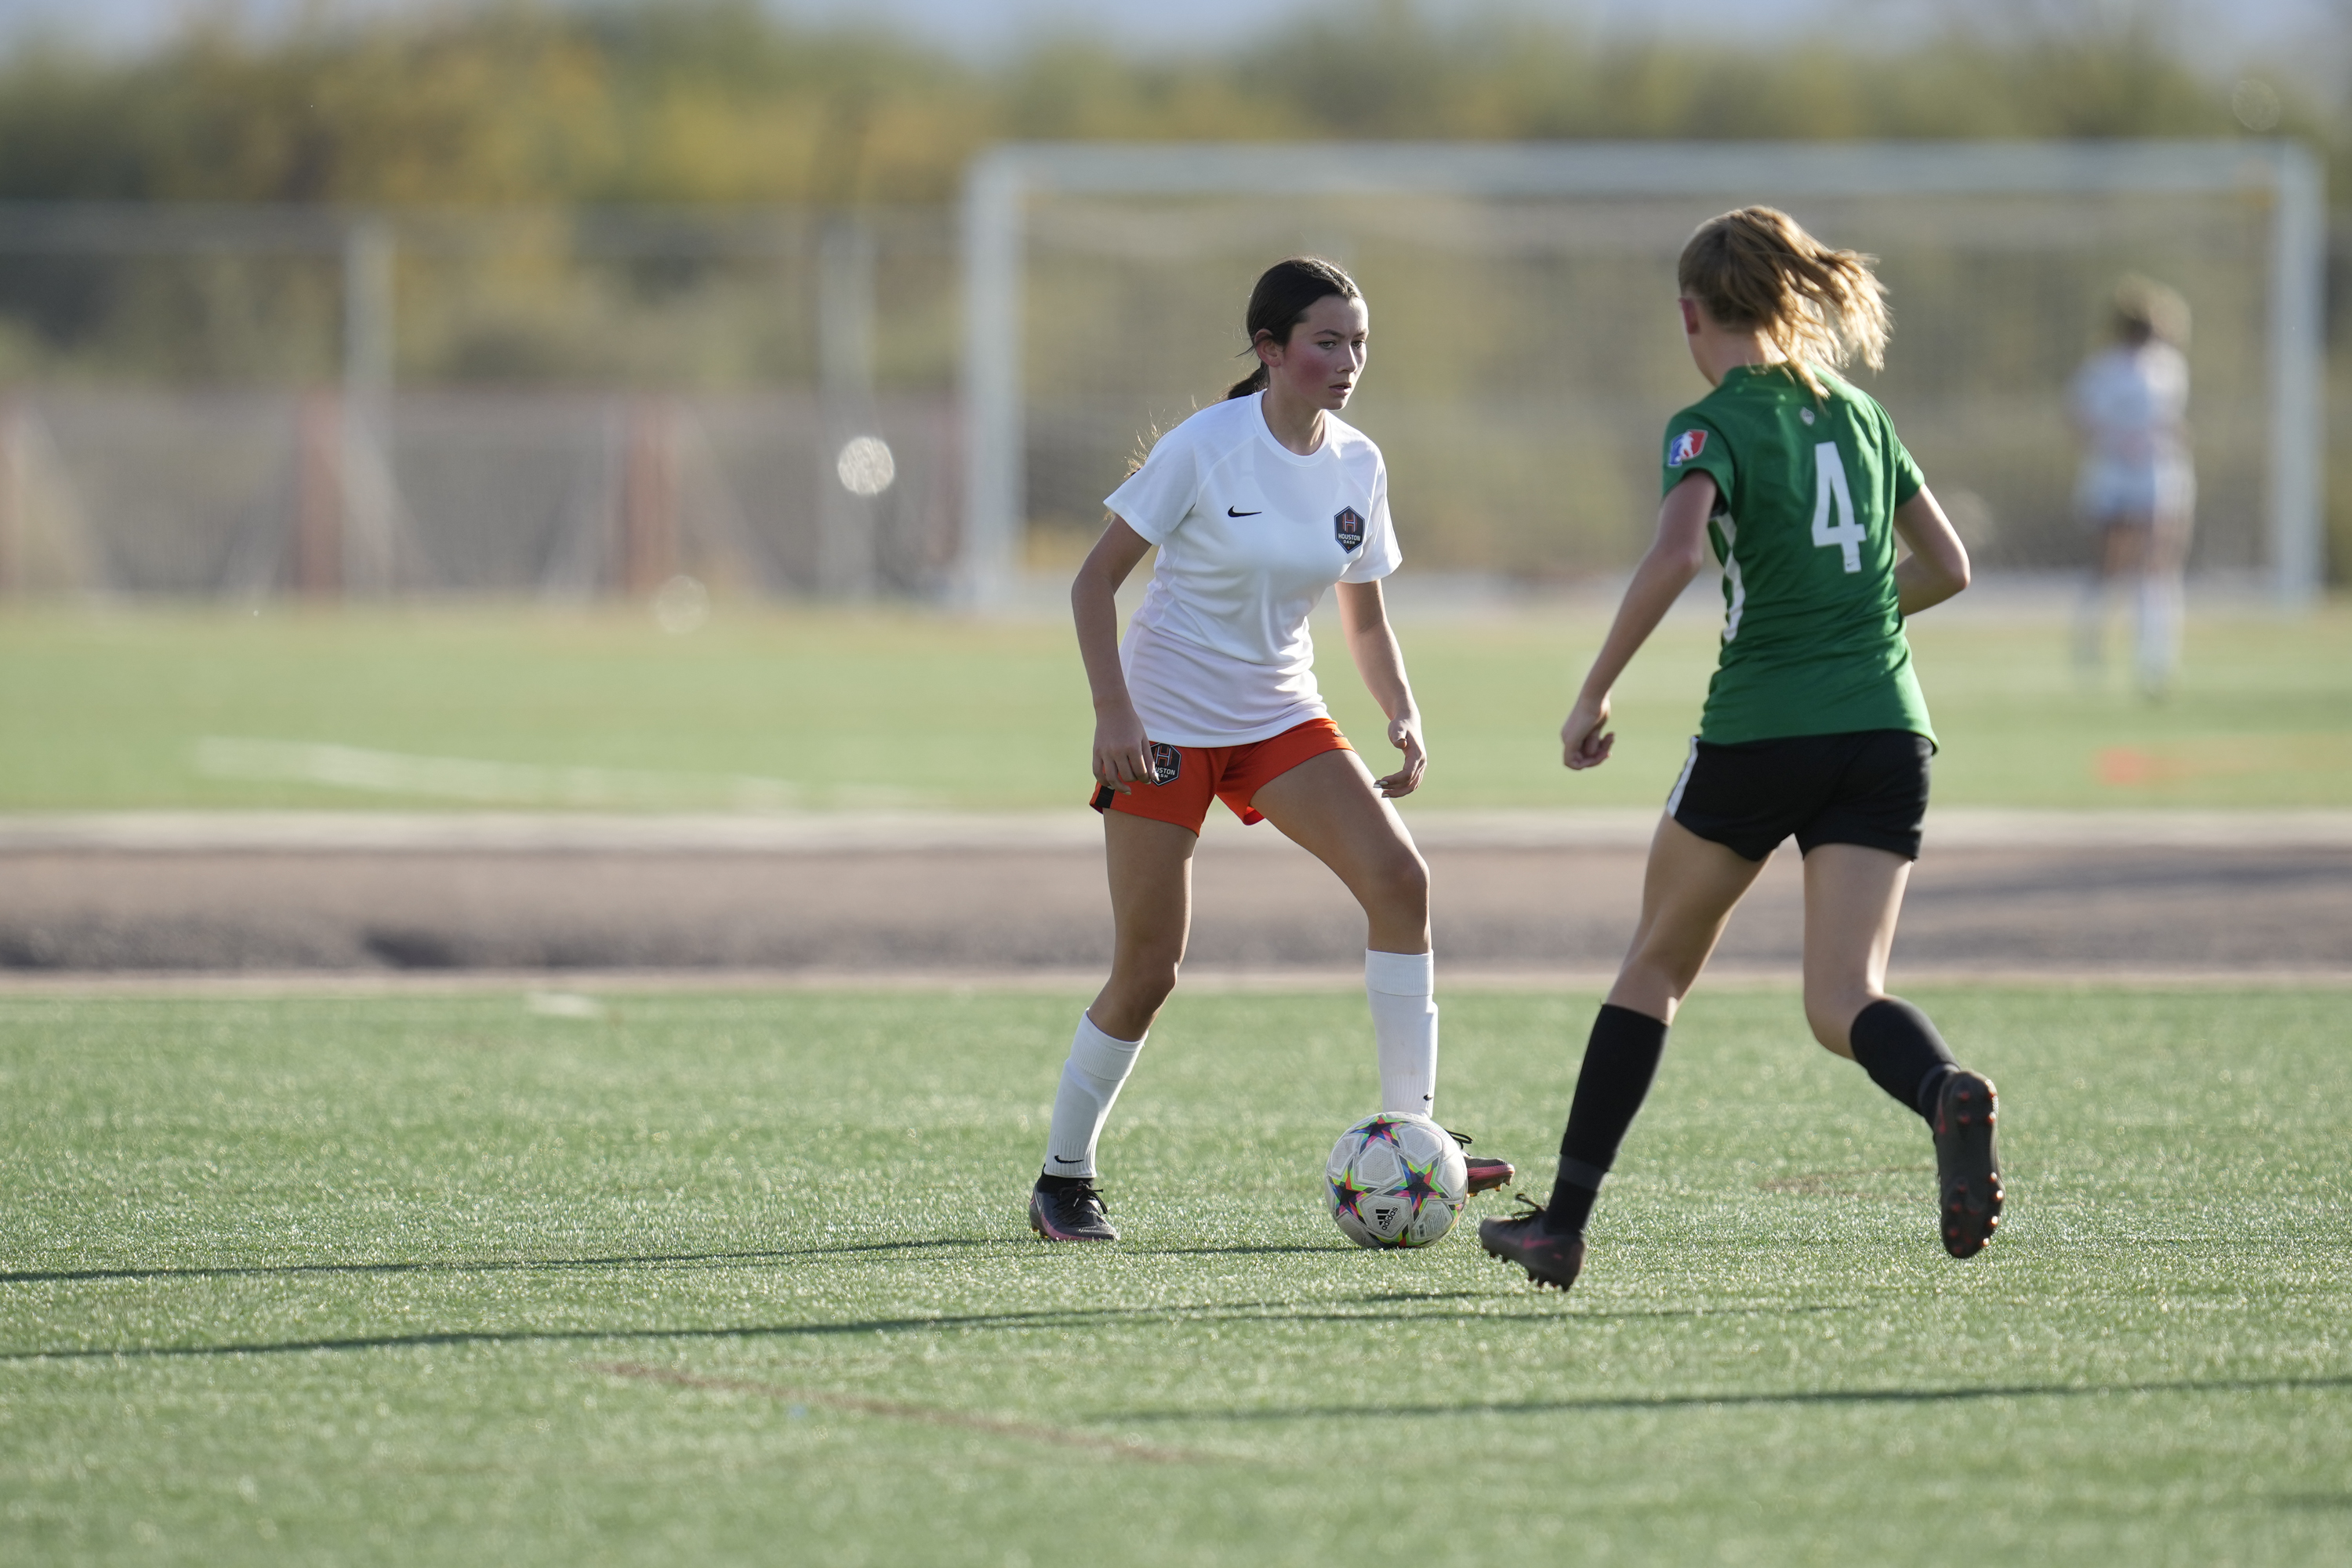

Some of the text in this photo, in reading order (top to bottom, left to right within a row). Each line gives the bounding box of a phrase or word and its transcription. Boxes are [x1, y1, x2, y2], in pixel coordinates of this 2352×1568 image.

[1811, 441, 1867, 573] 4
[1342, 512, 1357, 533] H
[1338, 533, 1361, 542] HOUSTON
[1155, 766, 1176, 776] USTON
[1381, 1207, 1399, 1231] adidas
